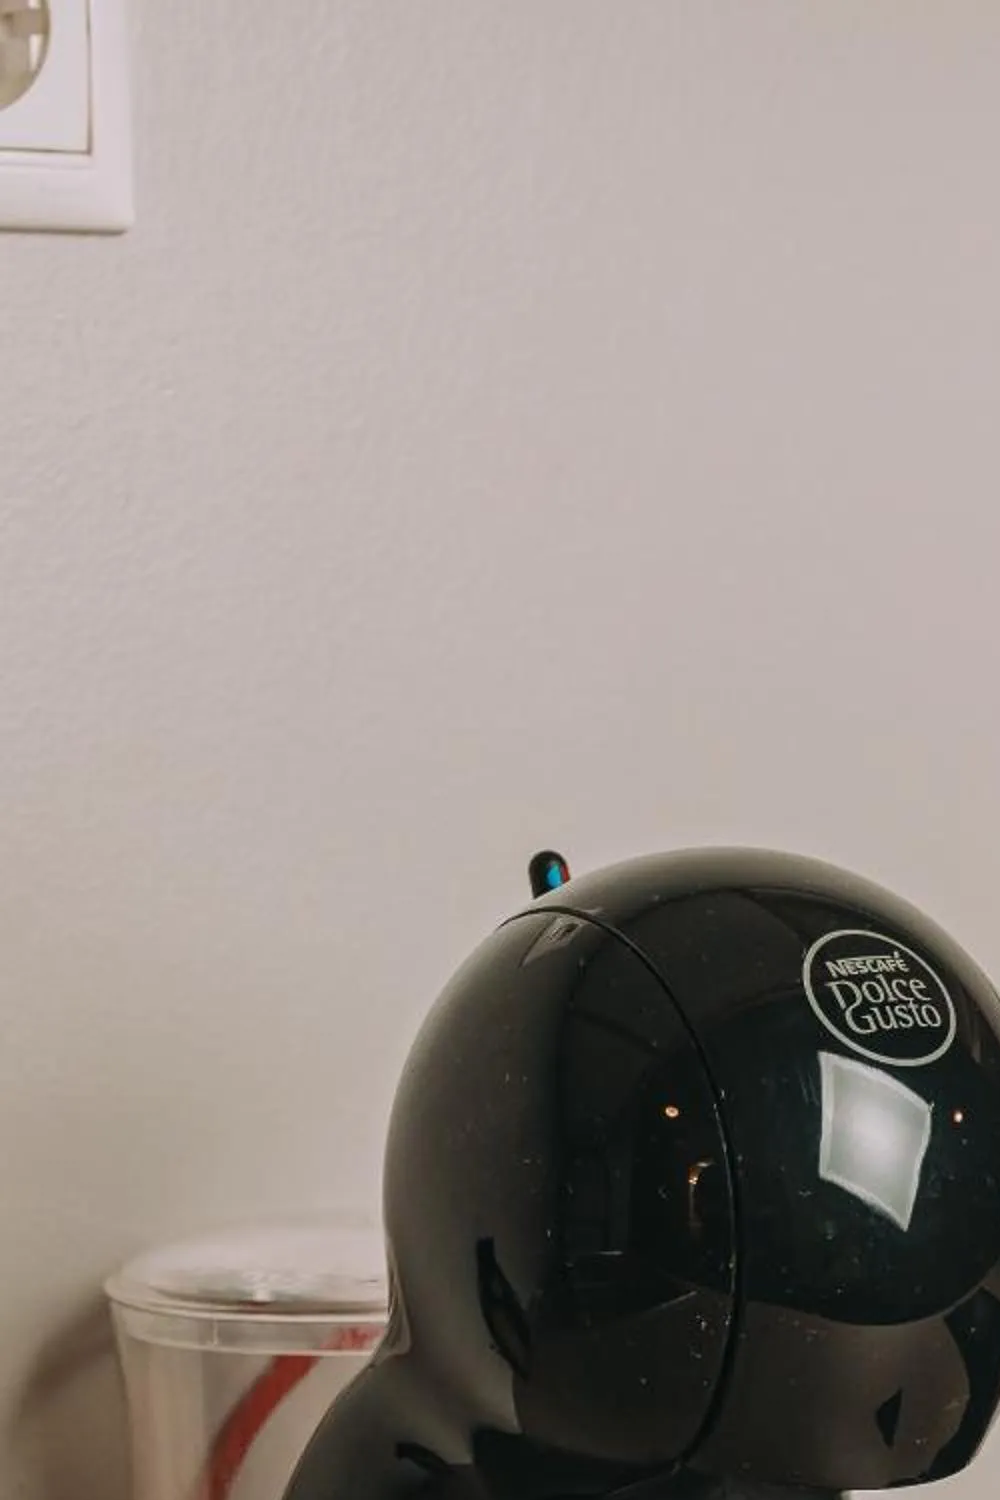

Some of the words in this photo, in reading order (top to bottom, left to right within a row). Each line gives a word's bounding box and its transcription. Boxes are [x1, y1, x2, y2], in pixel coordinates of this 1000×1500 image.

[825, 951, 910, 978] NESCAFÉ
[825, 974, 932, 1010] Dolce
[846, 1000, 941, 1034] Gusto
